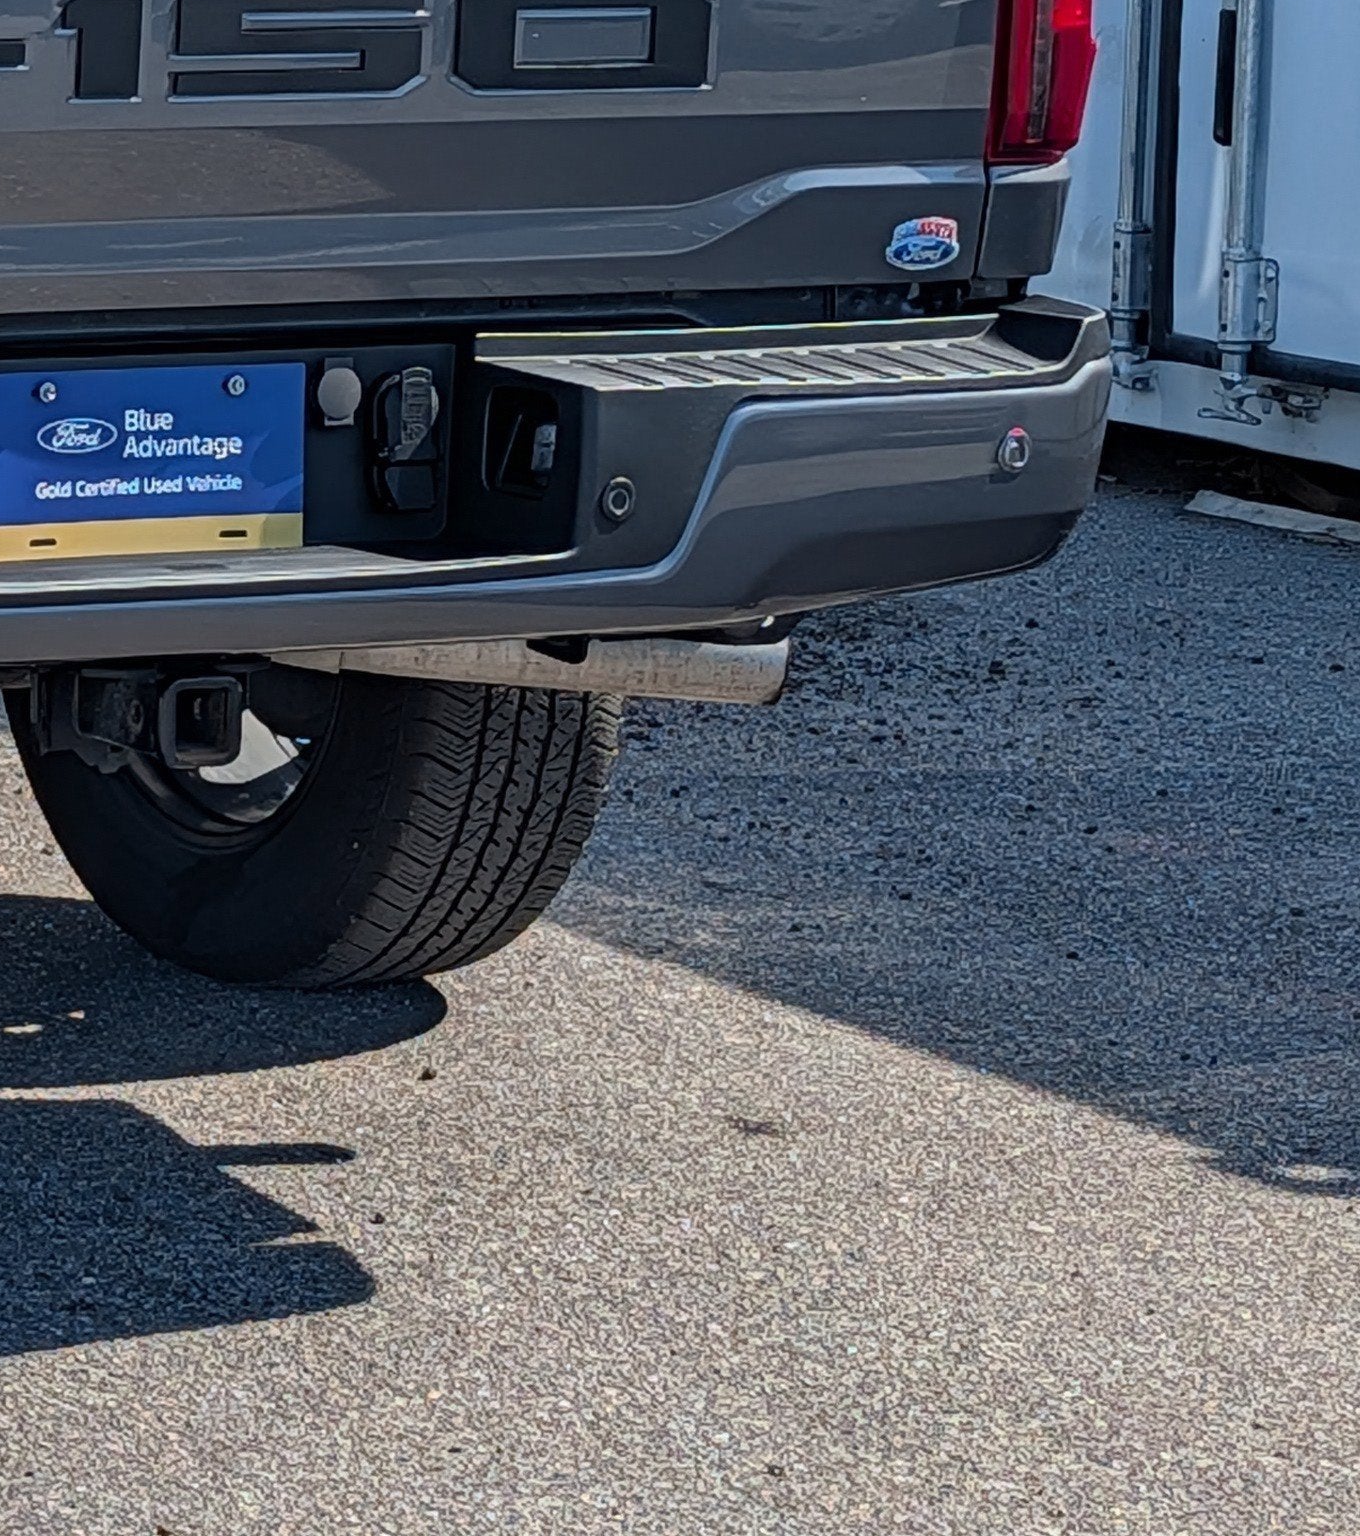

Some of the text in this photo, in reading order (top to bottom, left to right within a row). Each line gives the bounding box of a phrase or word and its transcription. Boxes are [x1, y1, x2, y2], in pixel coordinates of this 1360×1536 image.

[124, 409, 173, 430] Blue
[51, 422, 102, 447] Ford
[122, 435, 243, 460] Advantage
[35, 473, 243, 499] Gold Certified Used Vehicle
